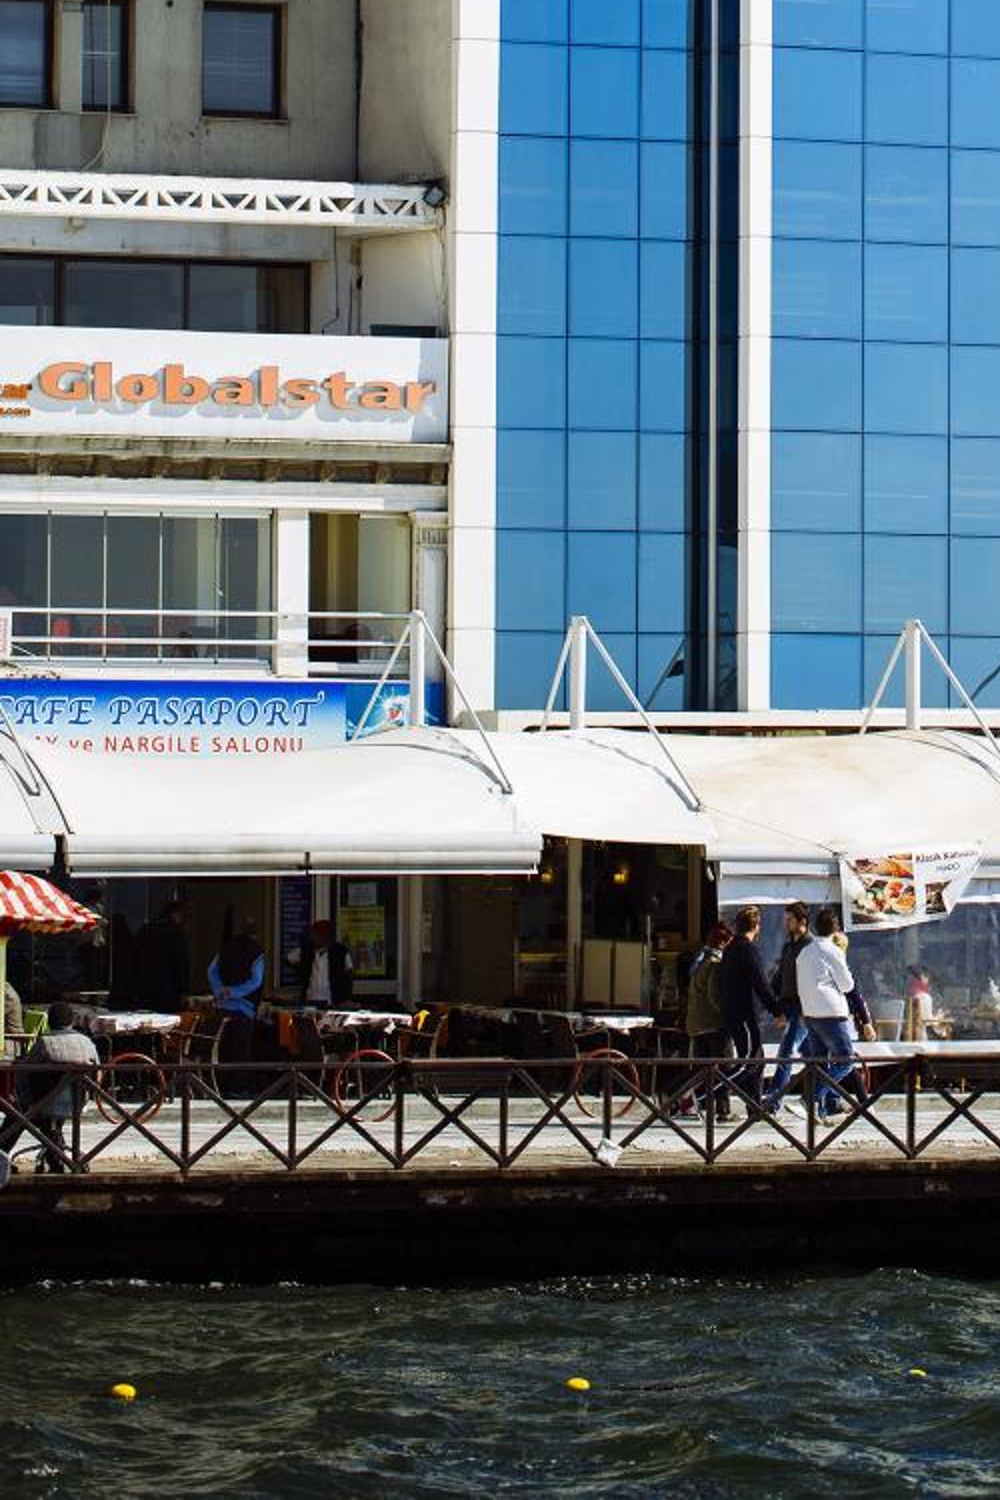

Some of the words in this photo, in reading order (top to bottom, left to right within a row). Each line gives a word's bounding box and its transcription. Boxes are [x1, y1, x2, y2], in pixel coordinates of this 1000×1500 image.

[38, 361, 437, 411] Globalstar
[109, 691, 325, 727] PASAPORT
[104, 733, 201, 753] NARGİLE
[211, 736, 304, 754] SALONU
